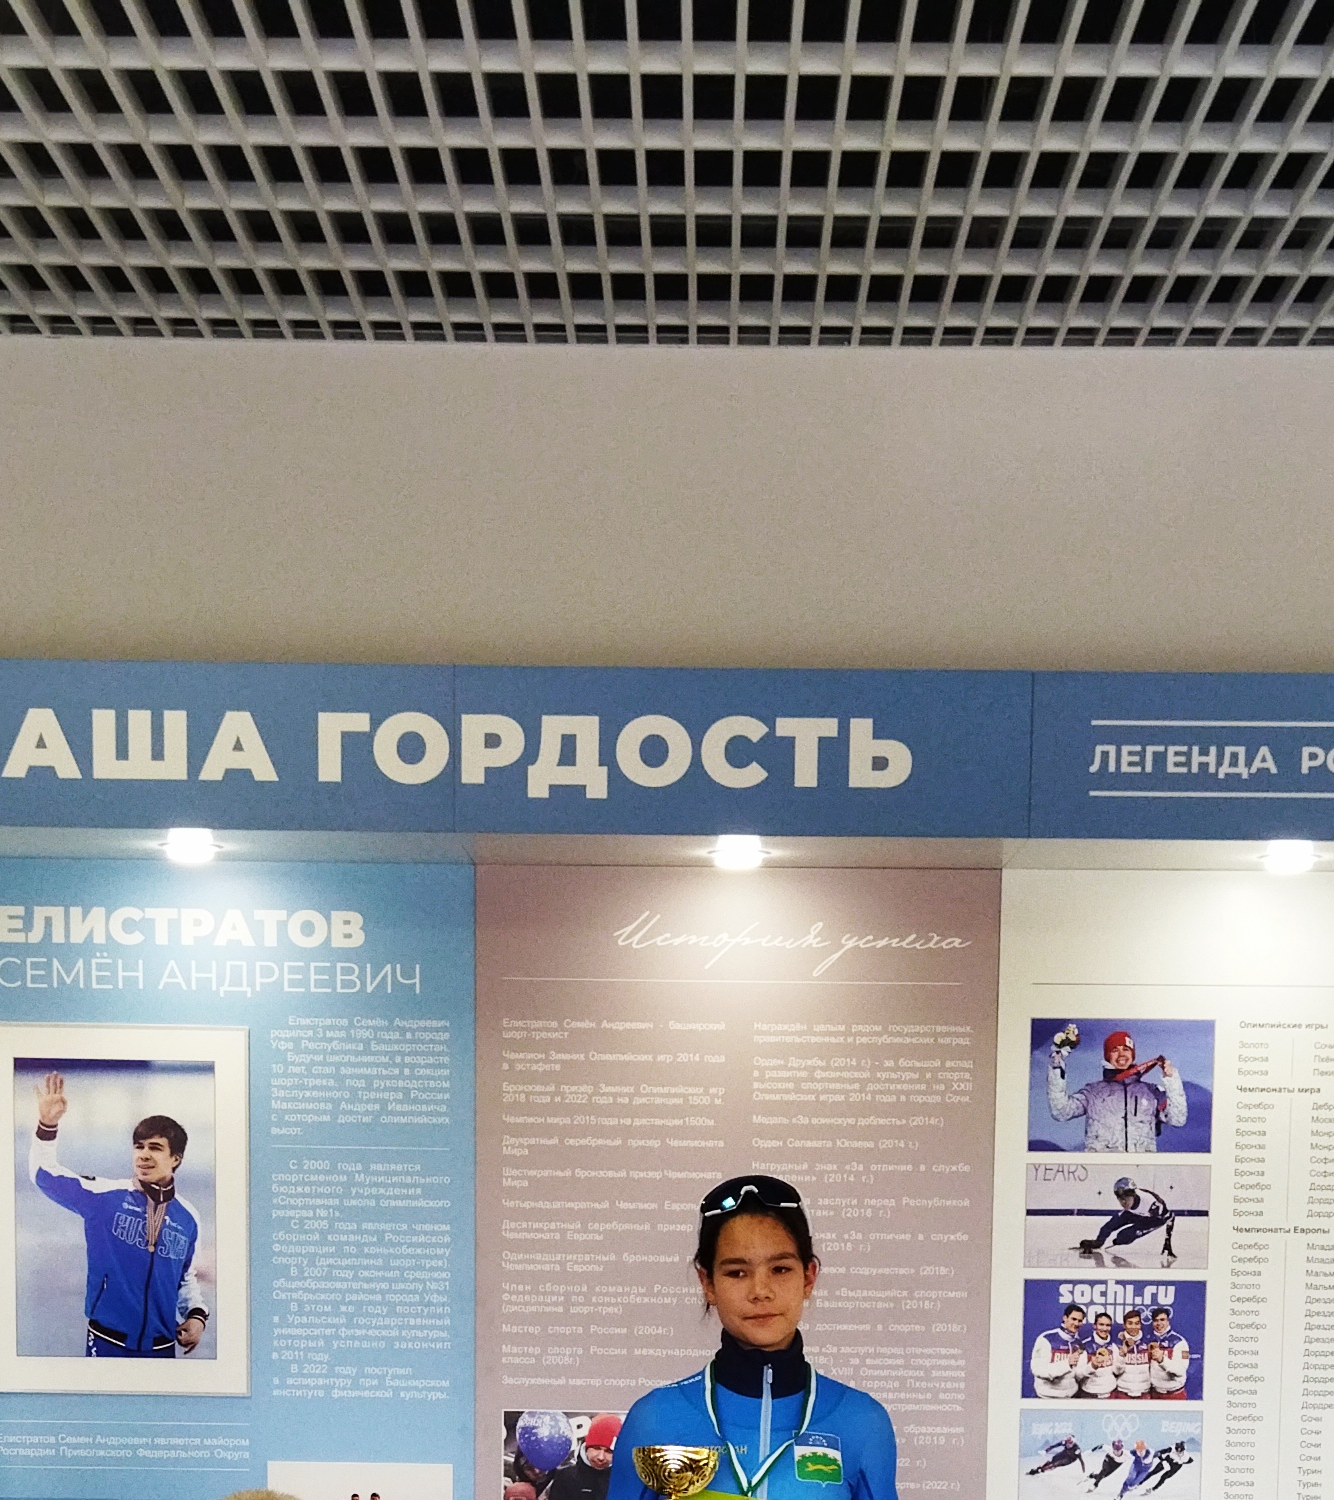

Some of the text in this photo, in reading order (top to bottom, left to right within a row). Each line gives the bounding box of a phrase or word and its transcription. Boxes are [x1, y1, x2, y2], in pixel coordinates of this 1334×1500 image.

[317, 712, 913, 800] ГОРДОСТЬ
[1089, 744, 1277, 780] ЛЕГЕНДА
[612, 909, 971, 976] История успеха
[158, 960, 421, 996] АНДРЕЕВИЧ
[288, 1016, 449, 1028] Елистратов Семён Андреевич
[1239, 1020, 1329, 1031] Олимпийские игры
[271, 1029, 313, 1039] родился
[317, 1029, 323, 1038] 3
[350, 1029, 374, 1039] 1990
[302, 1040, 363, 1052] Республика
[1238, 1041, 1269, 1050] Золото
[287, 1052, 323, 1063] Будучи
[676, 1053, 700, 1063] 2014
[1238, 1054, 1269, 1064] Бронза
[272, 1064, 283, 1073] 10
[1238, 1068, 1269, 1078] Бронза
[373, 1080, 450, 1089] руководством
[271, 1088, 350, 1099] Заслуженного
[410, 1090, 450, 1100] России
[1236, 1085, 1321, 1096] Чемпионаты мира
[271, 1101, 379, 1112] Максимова Андрея
[1236, 1102, 1274, 1111] Серебро
[380, 1115, 450, 1124] олимпийских
[303, 1160, 421, 1172] 2000 года является
[1034, 1164, 1088, 1182] YEARS
[272, 1173, 450, 1185] спортсменом Муниципального
[272, 1184, 422, 1196] бюджетного учреждения
[344, 1198, 450, 1208] школа олимпийского
[304, 1220, 328, 1229] 2005
[335, 1222, 357, 1231] года
[362, 1223, 407, 1231] является
[1232, 1225, 1330, 1236] Чемпионаты Европы
[272, 1231, 450, 1243] сборной команды Российской
[272, 1243, 450, 1256] Федерации по конькобежному
[272, 1256, 308, 1266] спорту
[273, 1290, 342, 1301] Октябрьского
[1059, 1279, 1175, 1305] sochi.ru
[304, 1304, 450, 1315] этом году поступил
[287, 1314, 450, 1326] Уральский государственный
[502, 1323, 627, 1338] Мастер спорта России
[273, 1339, 451, 1350] который успешно закончил
[281, 1351, 304, 1360] 2011
[303, 1364, 412, 1376] 2022 году поступил
[287, 1377, 449, 1388] аспирантуру Башкирском
[136, 1448, 210, 1459] Федерального
[1225, 1453, 1255, 1462] Золото
[1299, 1453, 1322, 1464] Сочи
